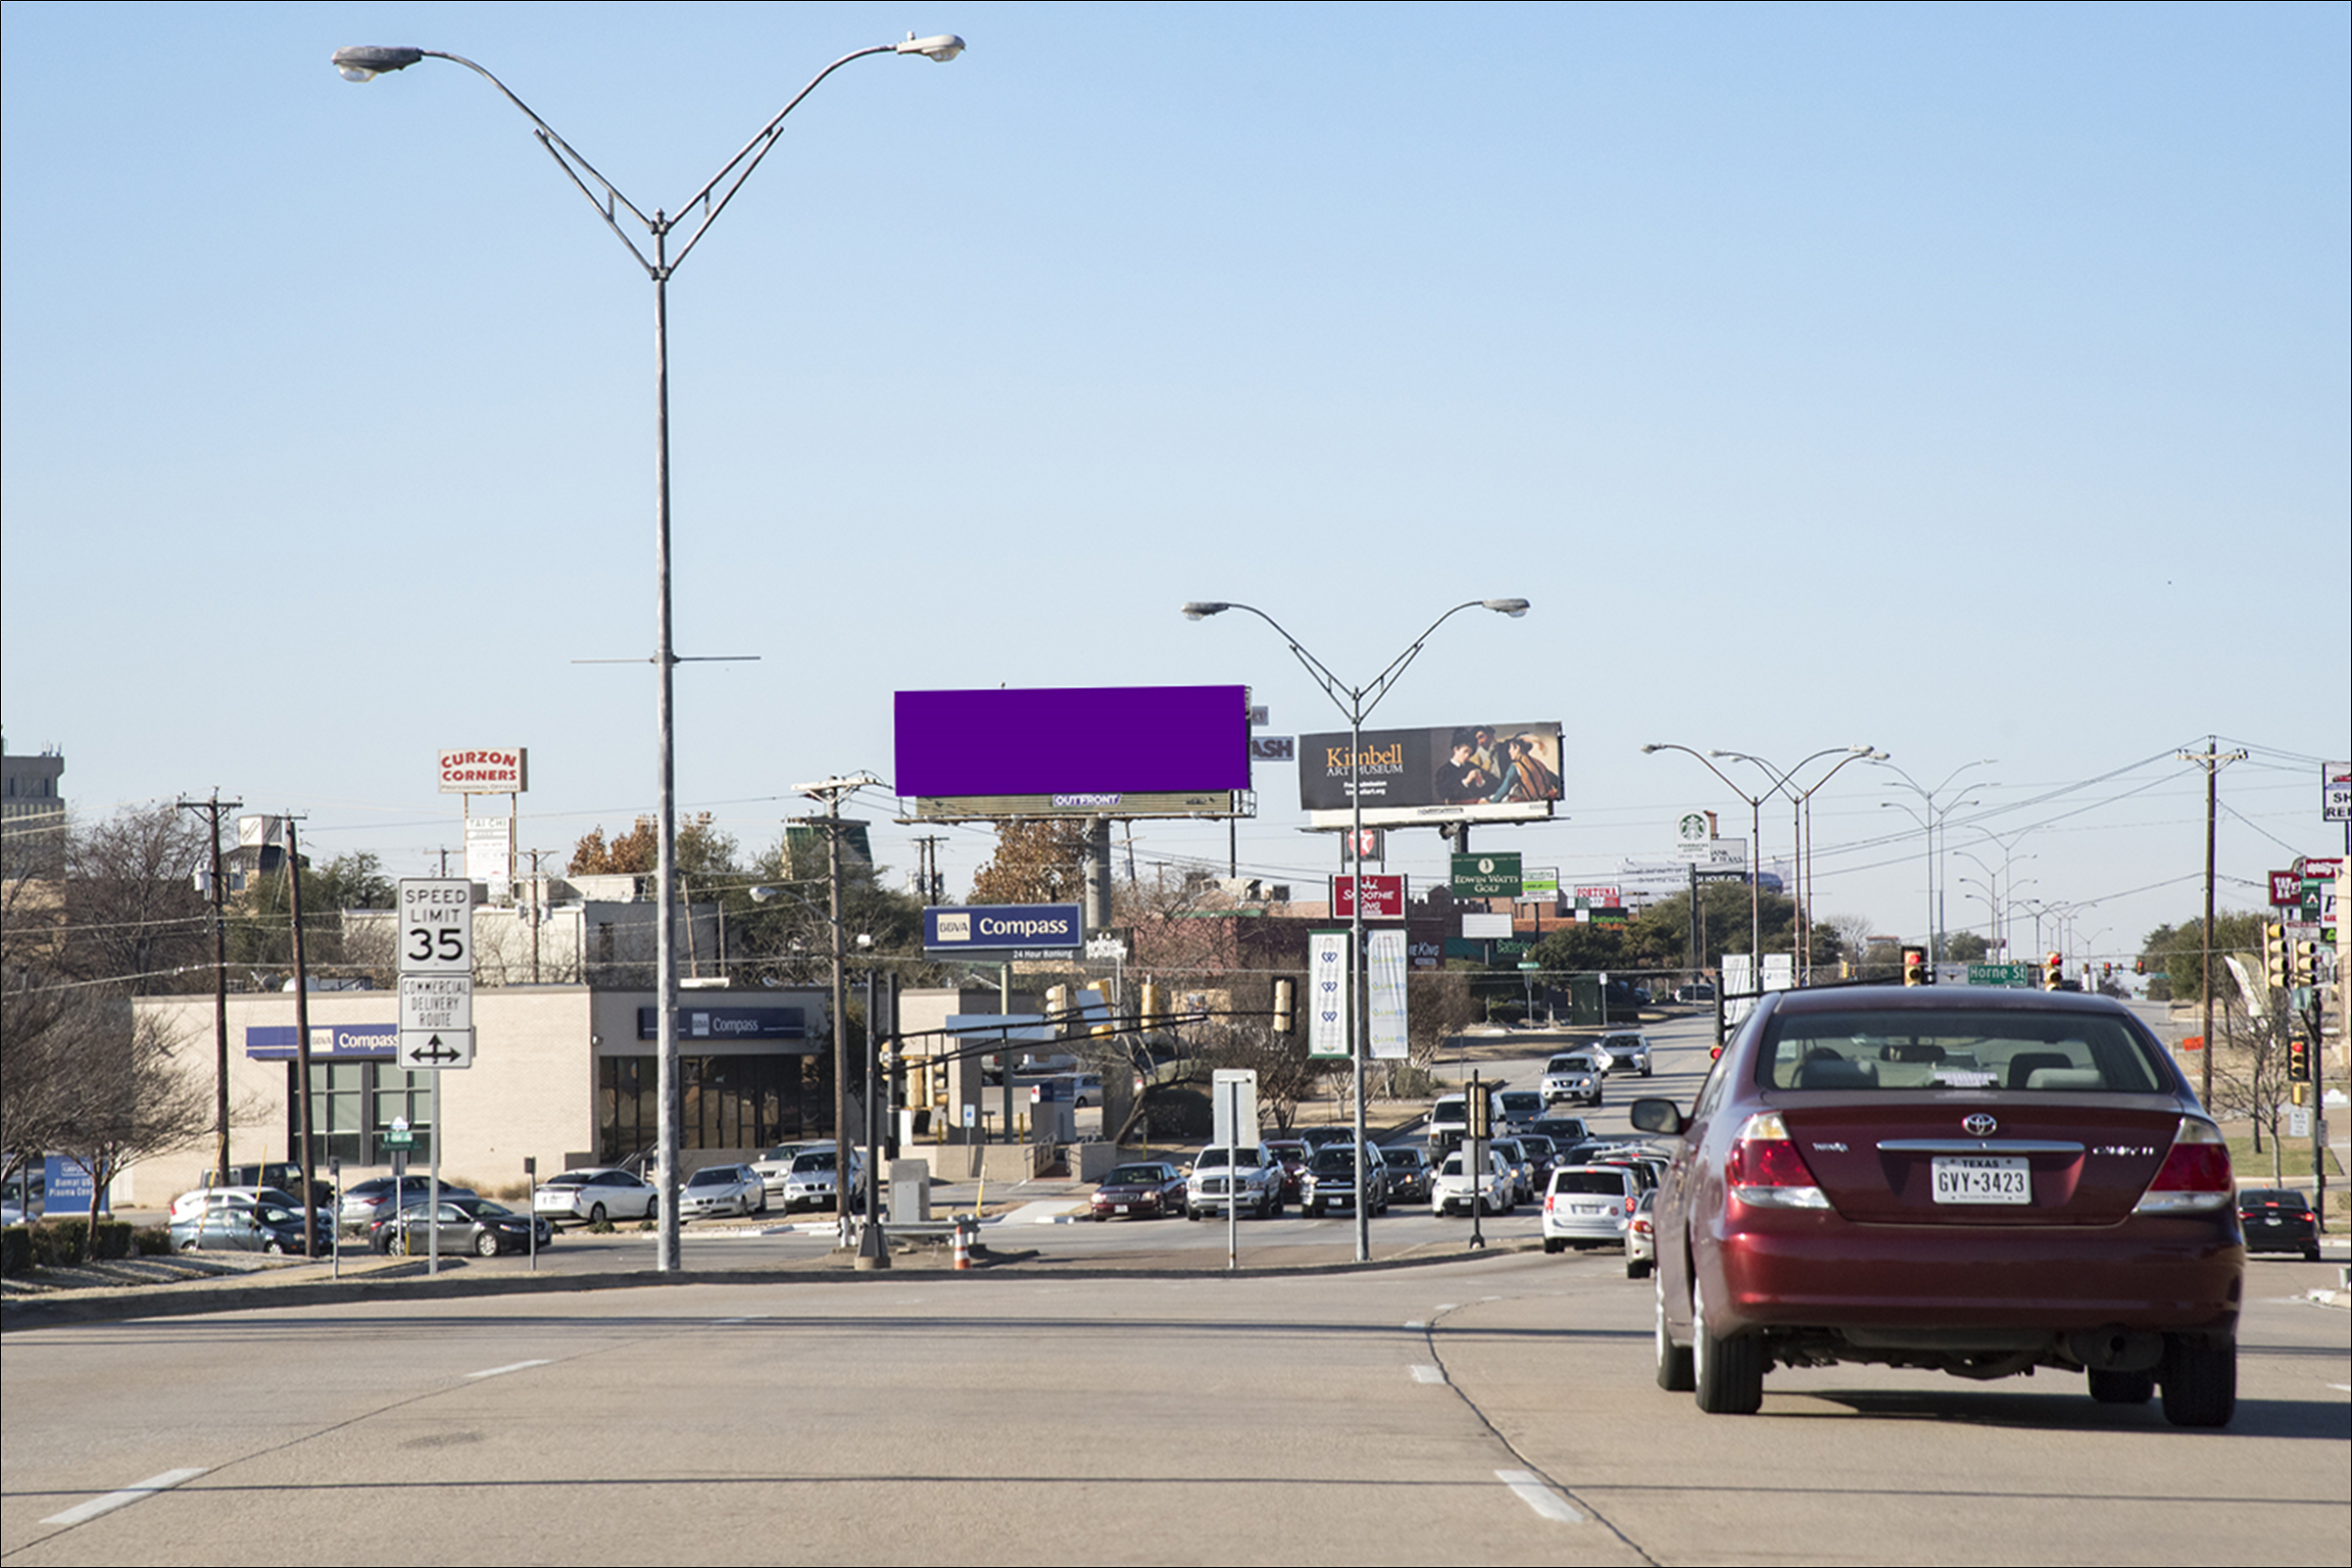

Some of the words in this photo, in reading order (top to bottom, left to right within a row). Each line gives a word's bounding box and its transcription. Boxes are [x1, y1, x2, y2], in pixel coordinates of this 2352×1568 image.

[441, 752, 516, 768] CURZON
[1326, 744, 1402, 767] Kimbell
[442, 770, 516, 781] CORNERS
[1326, 766, 1350, 777] ART
[1054, 795, 1120, 806] OUTFRONT
[469, 819, 486, 828] TAI
[488, 818, 507, 828] CHI
[1454, 874, 1487, 884] EDWIN
[1489, 874, 1519, 883] WATTS
[1474, 884, 1499, 893] GOLF
[405, 889, 467, 904] SPEED
[411, 908, 461, 923] LIMIT
[979, 917, 1068, 938] Compass
[408, 928, 464, 960] 35
[1970, 966, 2008, 979] Horne
[2013, 965, 2025, 979] St
[403, 981, 468, 995] COMMERCIAL
[412, 997, 461, 1010] DELIVERY
[418, 1012, 452, 1027] ROUTE
[712, 1017, 759, 1034] Compass
[339, 1032, 398, 1052] Compass
[1962, 1159, 1999, 1168] TEXAS
